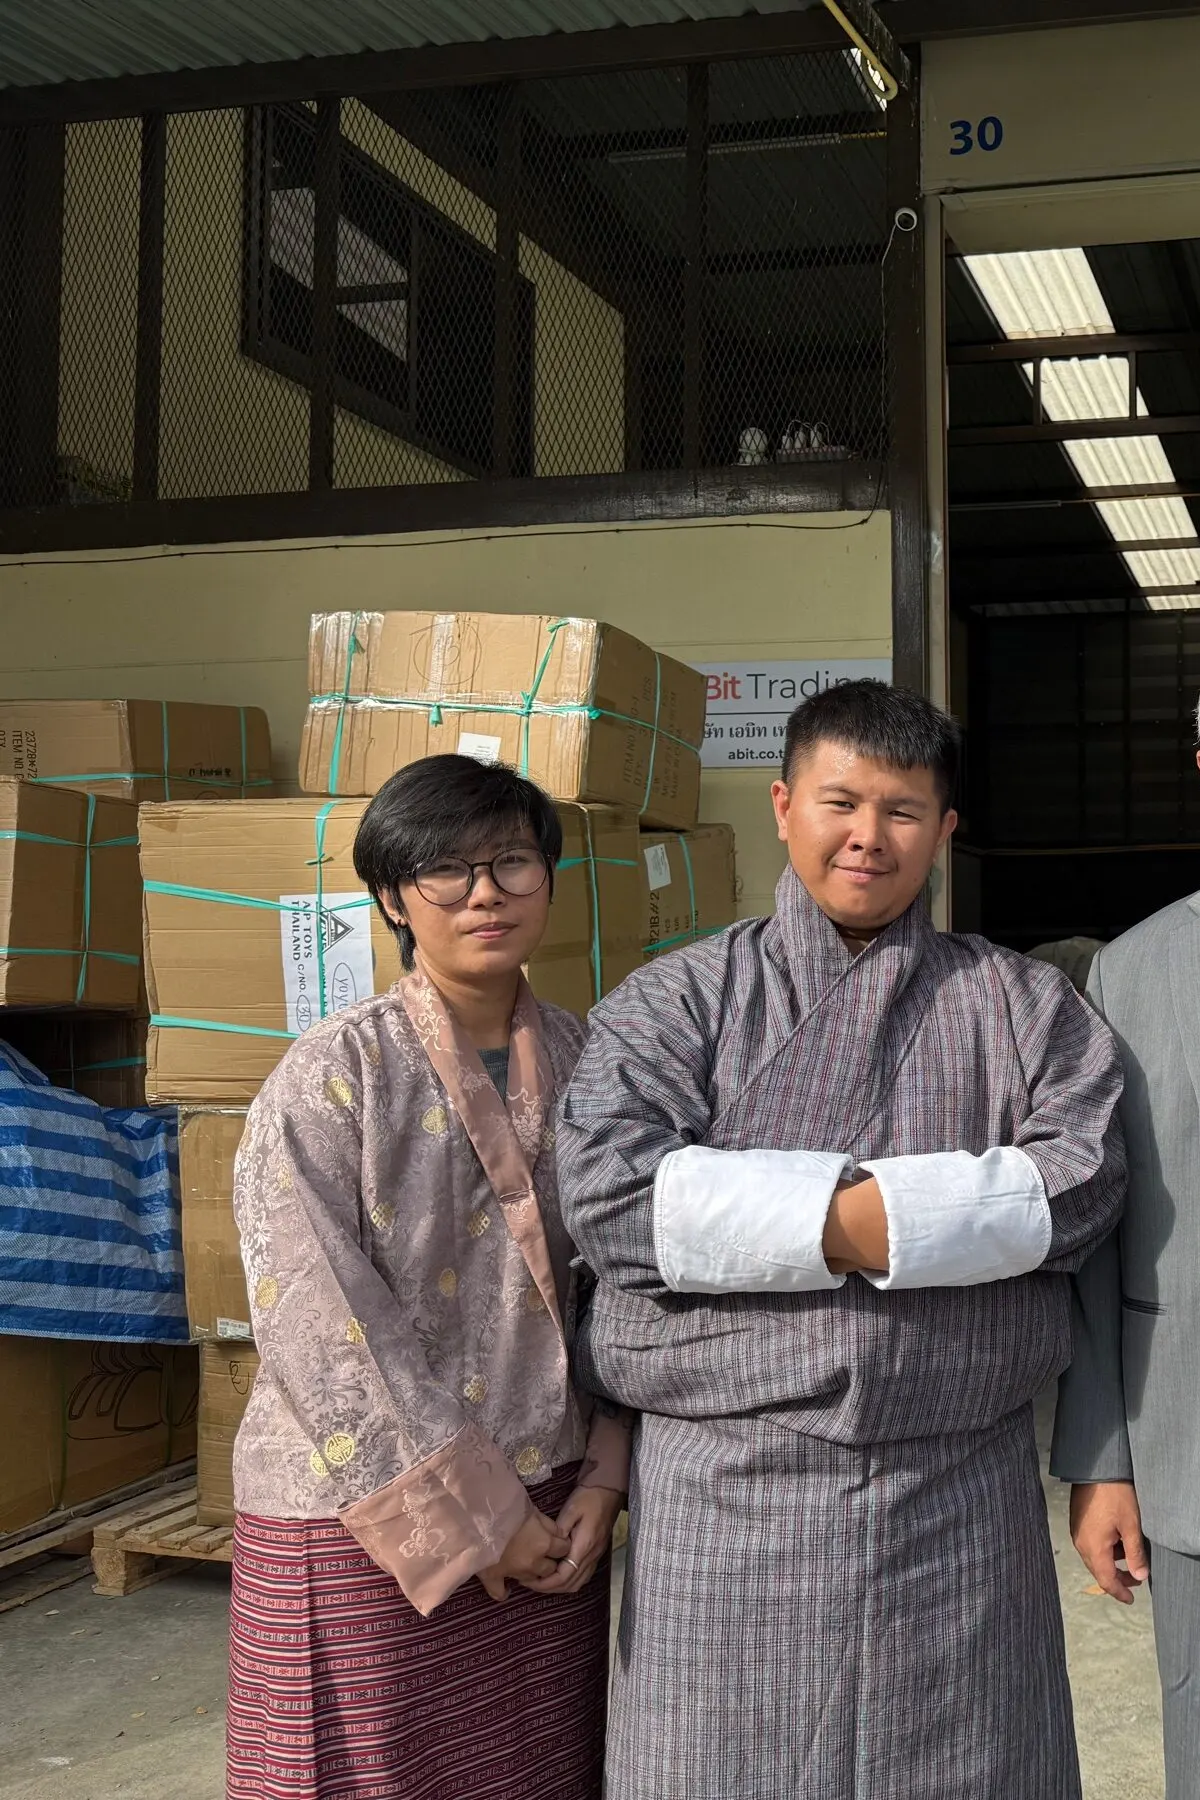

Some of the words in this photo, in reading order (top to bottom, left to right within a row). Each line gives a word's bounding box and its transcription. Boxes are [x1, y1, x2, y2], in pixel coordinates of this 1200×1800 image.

[949, 116, 1003, 155] 30
[706, 672, 742, 700] Bit
[12, 731, 23, 752] ITEM
[704, 723, 724, 739] ษัท
[773, 724, 788, 738] เท
[14, 757, 24, 770] NO
[728, 749, 785, 760] abit.co.t
[291, 900, 301, 961] THAILAND
[303, 925, 313, 959] TOYS
